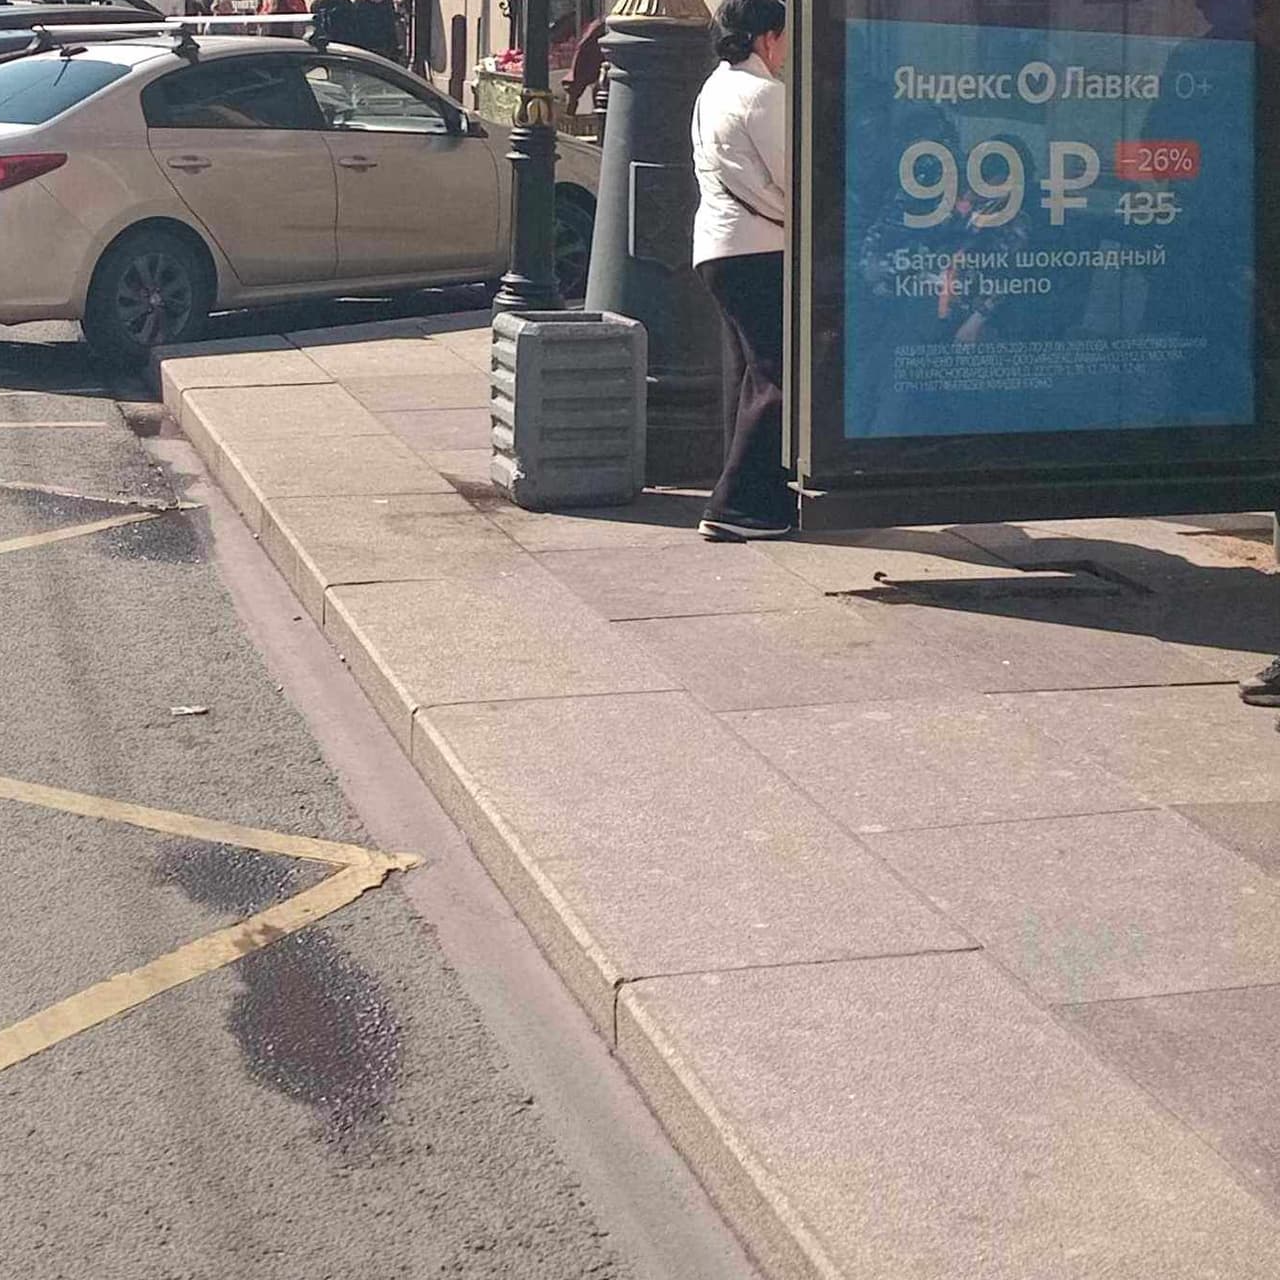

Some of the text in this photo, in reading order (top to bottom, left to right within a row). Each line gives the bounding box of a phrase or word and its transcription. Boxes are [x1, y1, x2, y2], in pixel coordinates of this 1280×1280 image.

[893, 65, 1213, 104] Яндекс Лавка 0+
[1117, 191, 1180, 226] 135
[895, 244, 1166, 271] Батончик шоколадный
[895, 274, 1052, 297] Kinder bueno
